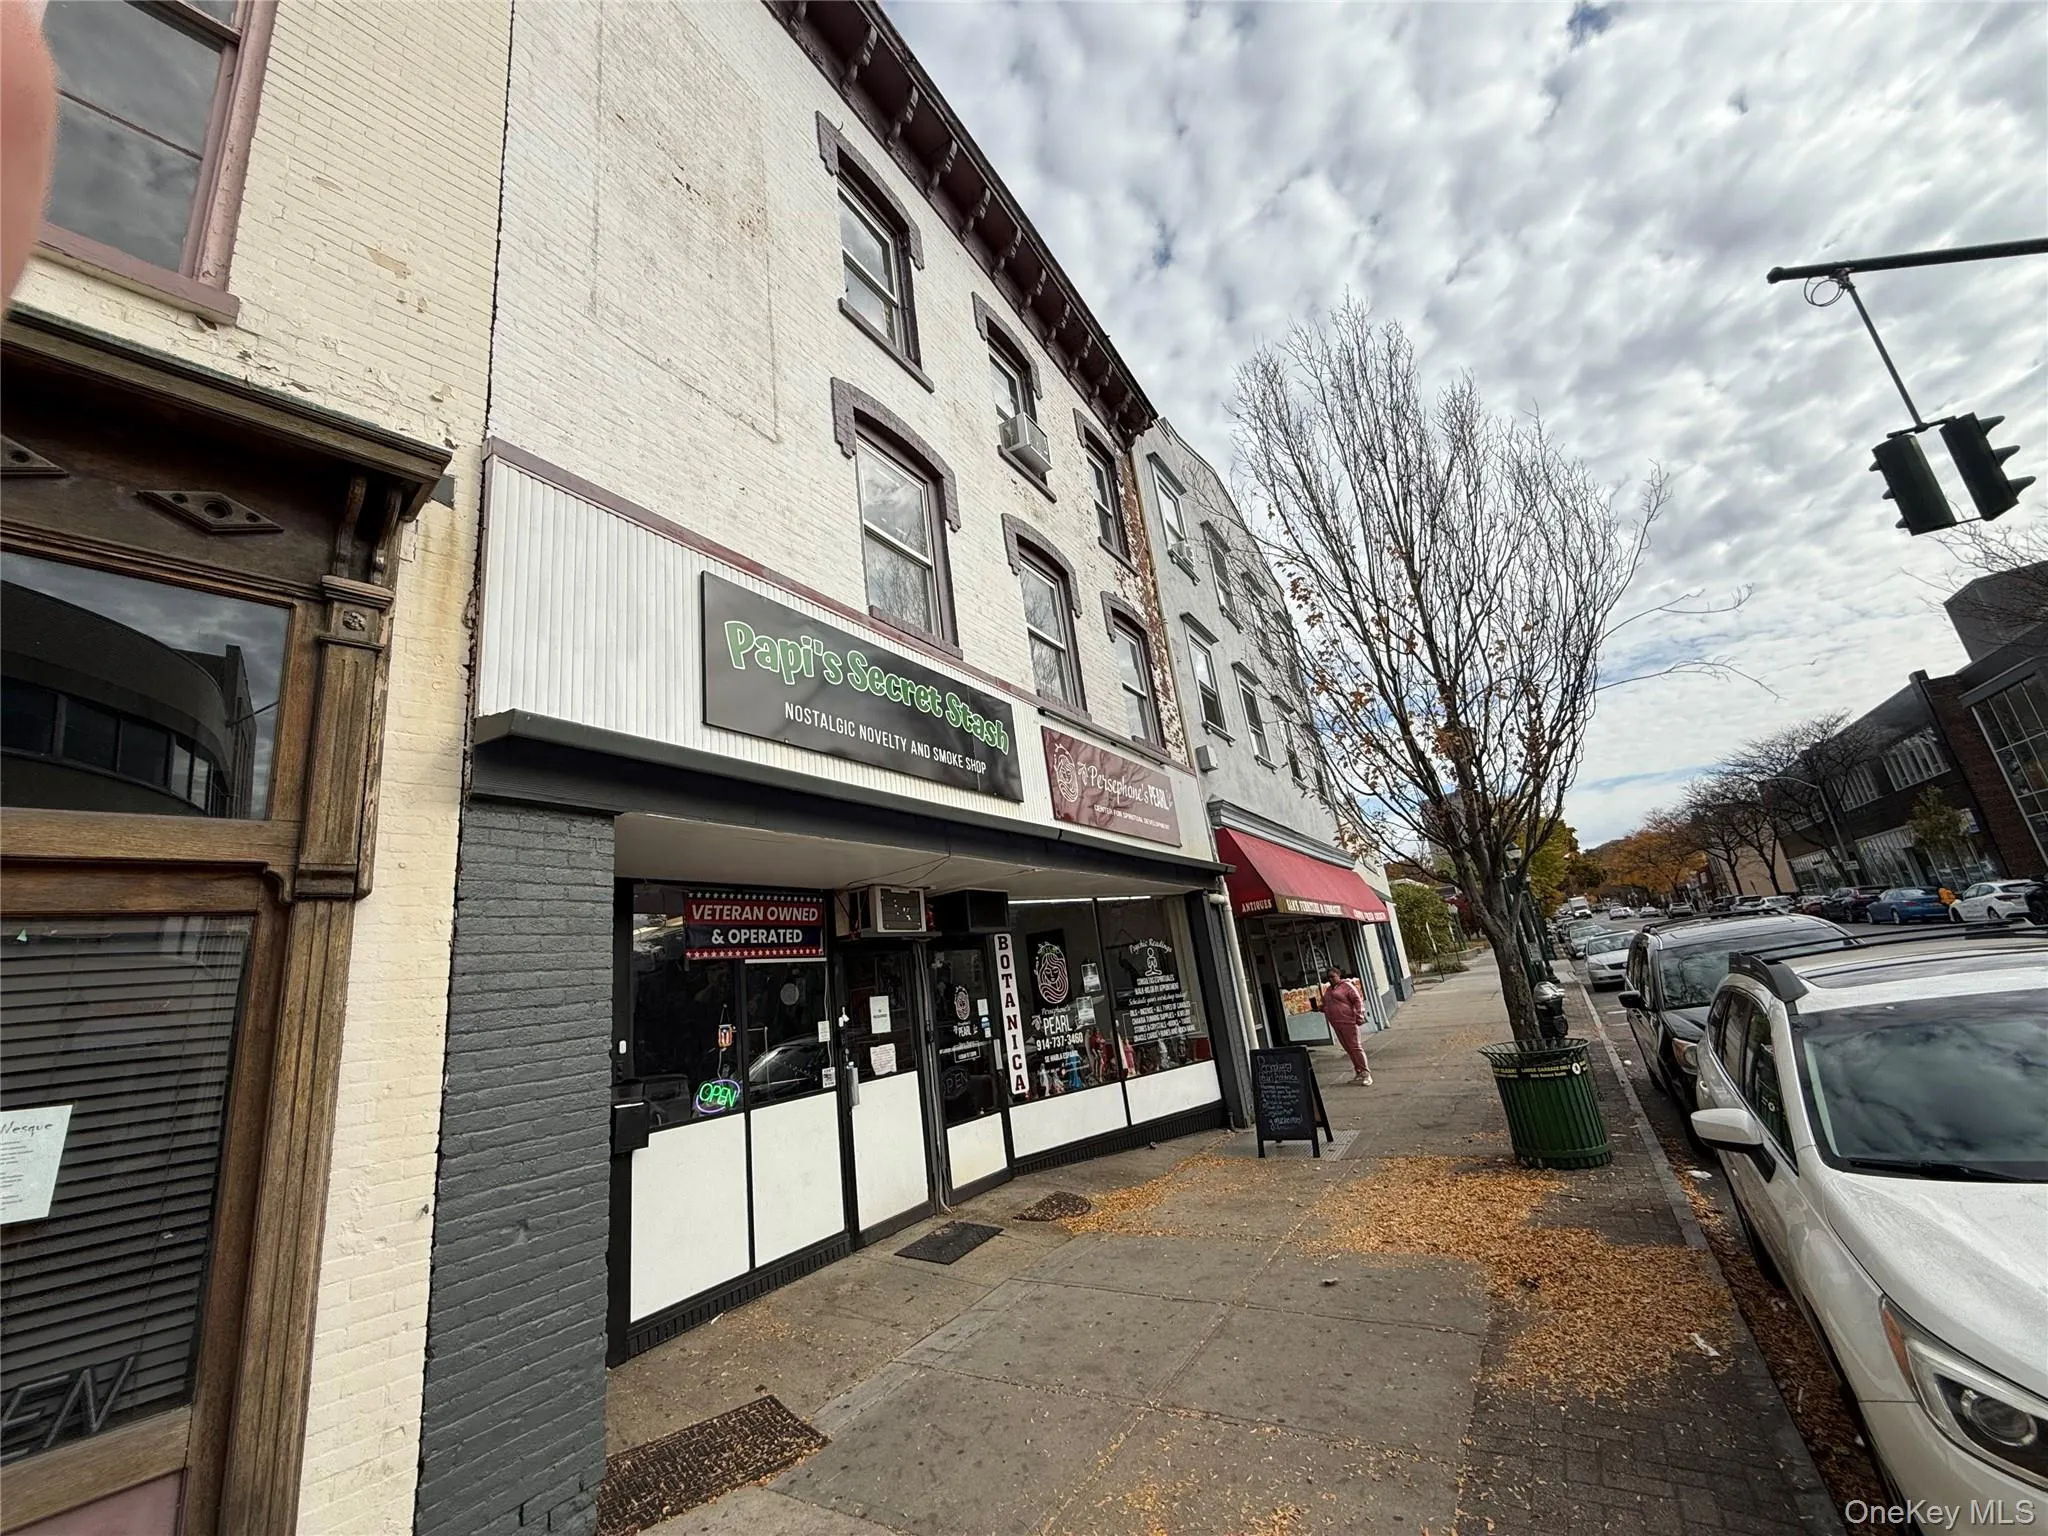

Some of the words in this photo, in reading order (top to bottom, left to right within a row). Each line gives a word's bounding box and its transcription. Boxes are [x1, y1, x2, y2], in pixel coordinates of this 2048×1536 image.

[724, 620, 844, 686] Papi's
[847, 650, 944, 718] Secret
[945, 692, 1010, 756] Stash
[785, 701, 856, 738] NOSTALGIC
[859, 724, 907, 752] NOVELTY
[911, 740, 931, 760] AND
[933, 747, 964, 769] SMOKE
[965, 757, 987, 775] SHOP
[1087, 765, 1149, 805] Persephone's
[1148, 785, 1170, 811] PEARL
[1094, 804, 1113, 815] CENTER
[691, 904, 764, 921] VETERAN
[767, 906, 818, 922] OWNED
[1242, 899, 1273, 913] ANTIQUES
[711, 928, 725, 945] &
[728, 928, 803, 944] OPERATED
[1128, 939, 1148, 955] Psychic
[1148, 938, 1173, 954] Readings
[998, 936, 1026, 1091] BOTANICA
[1043, 1014, 1073, 1036] PEARL
[1036, 1032, 1084, 1051] 914-737-3460
[699, 1083, 737, 1108] OPEN
